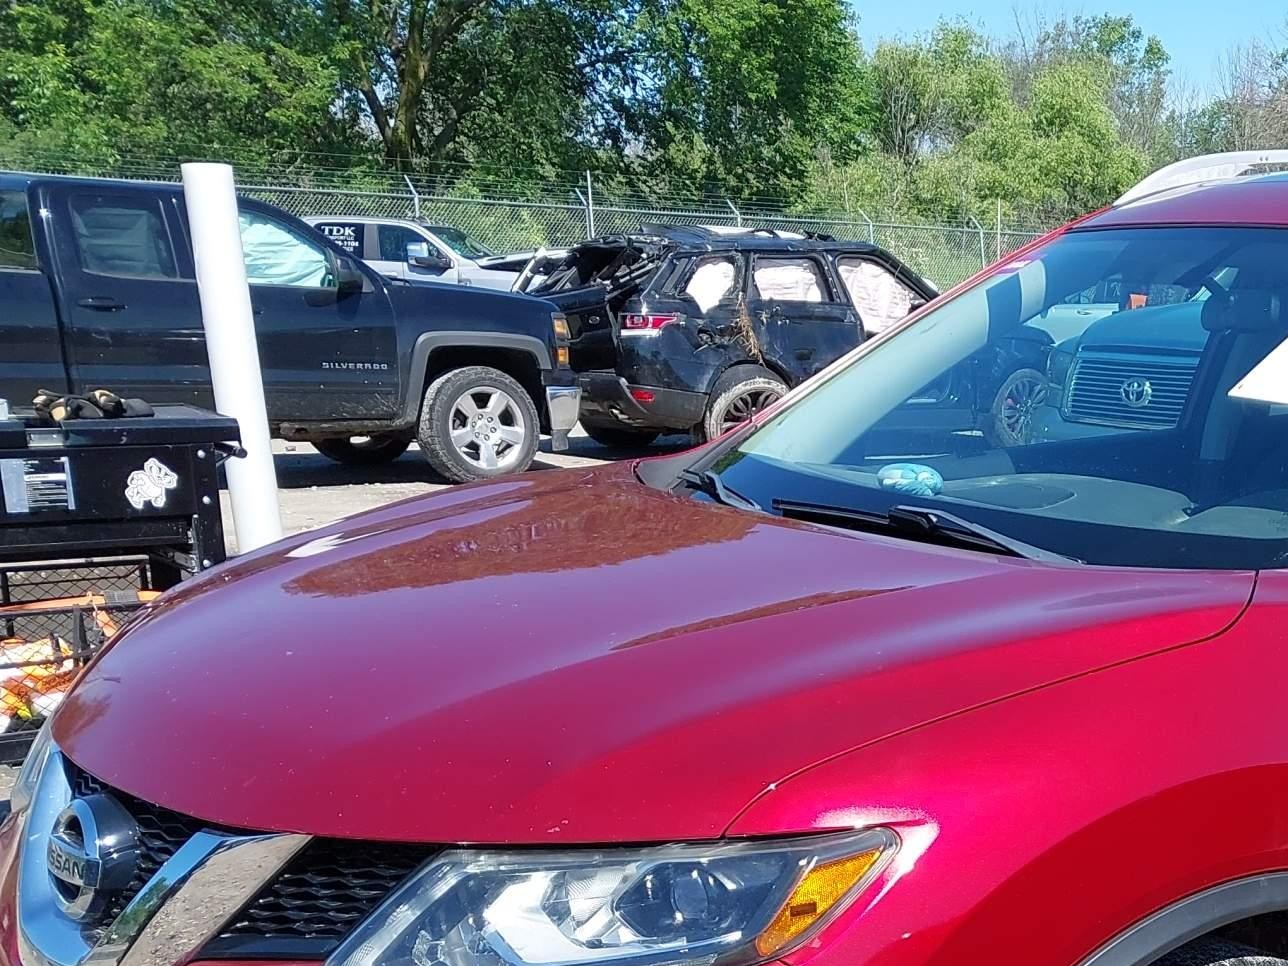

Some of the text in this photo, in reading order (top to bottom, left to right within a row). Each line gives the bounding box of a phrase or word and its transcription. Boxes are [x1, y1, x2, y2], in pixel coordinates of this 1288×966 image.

[321, 226, 356, 236] TDK
[321, 362, 388, 370] SILVERADO
[48, 850, 86, 881] SSAN
